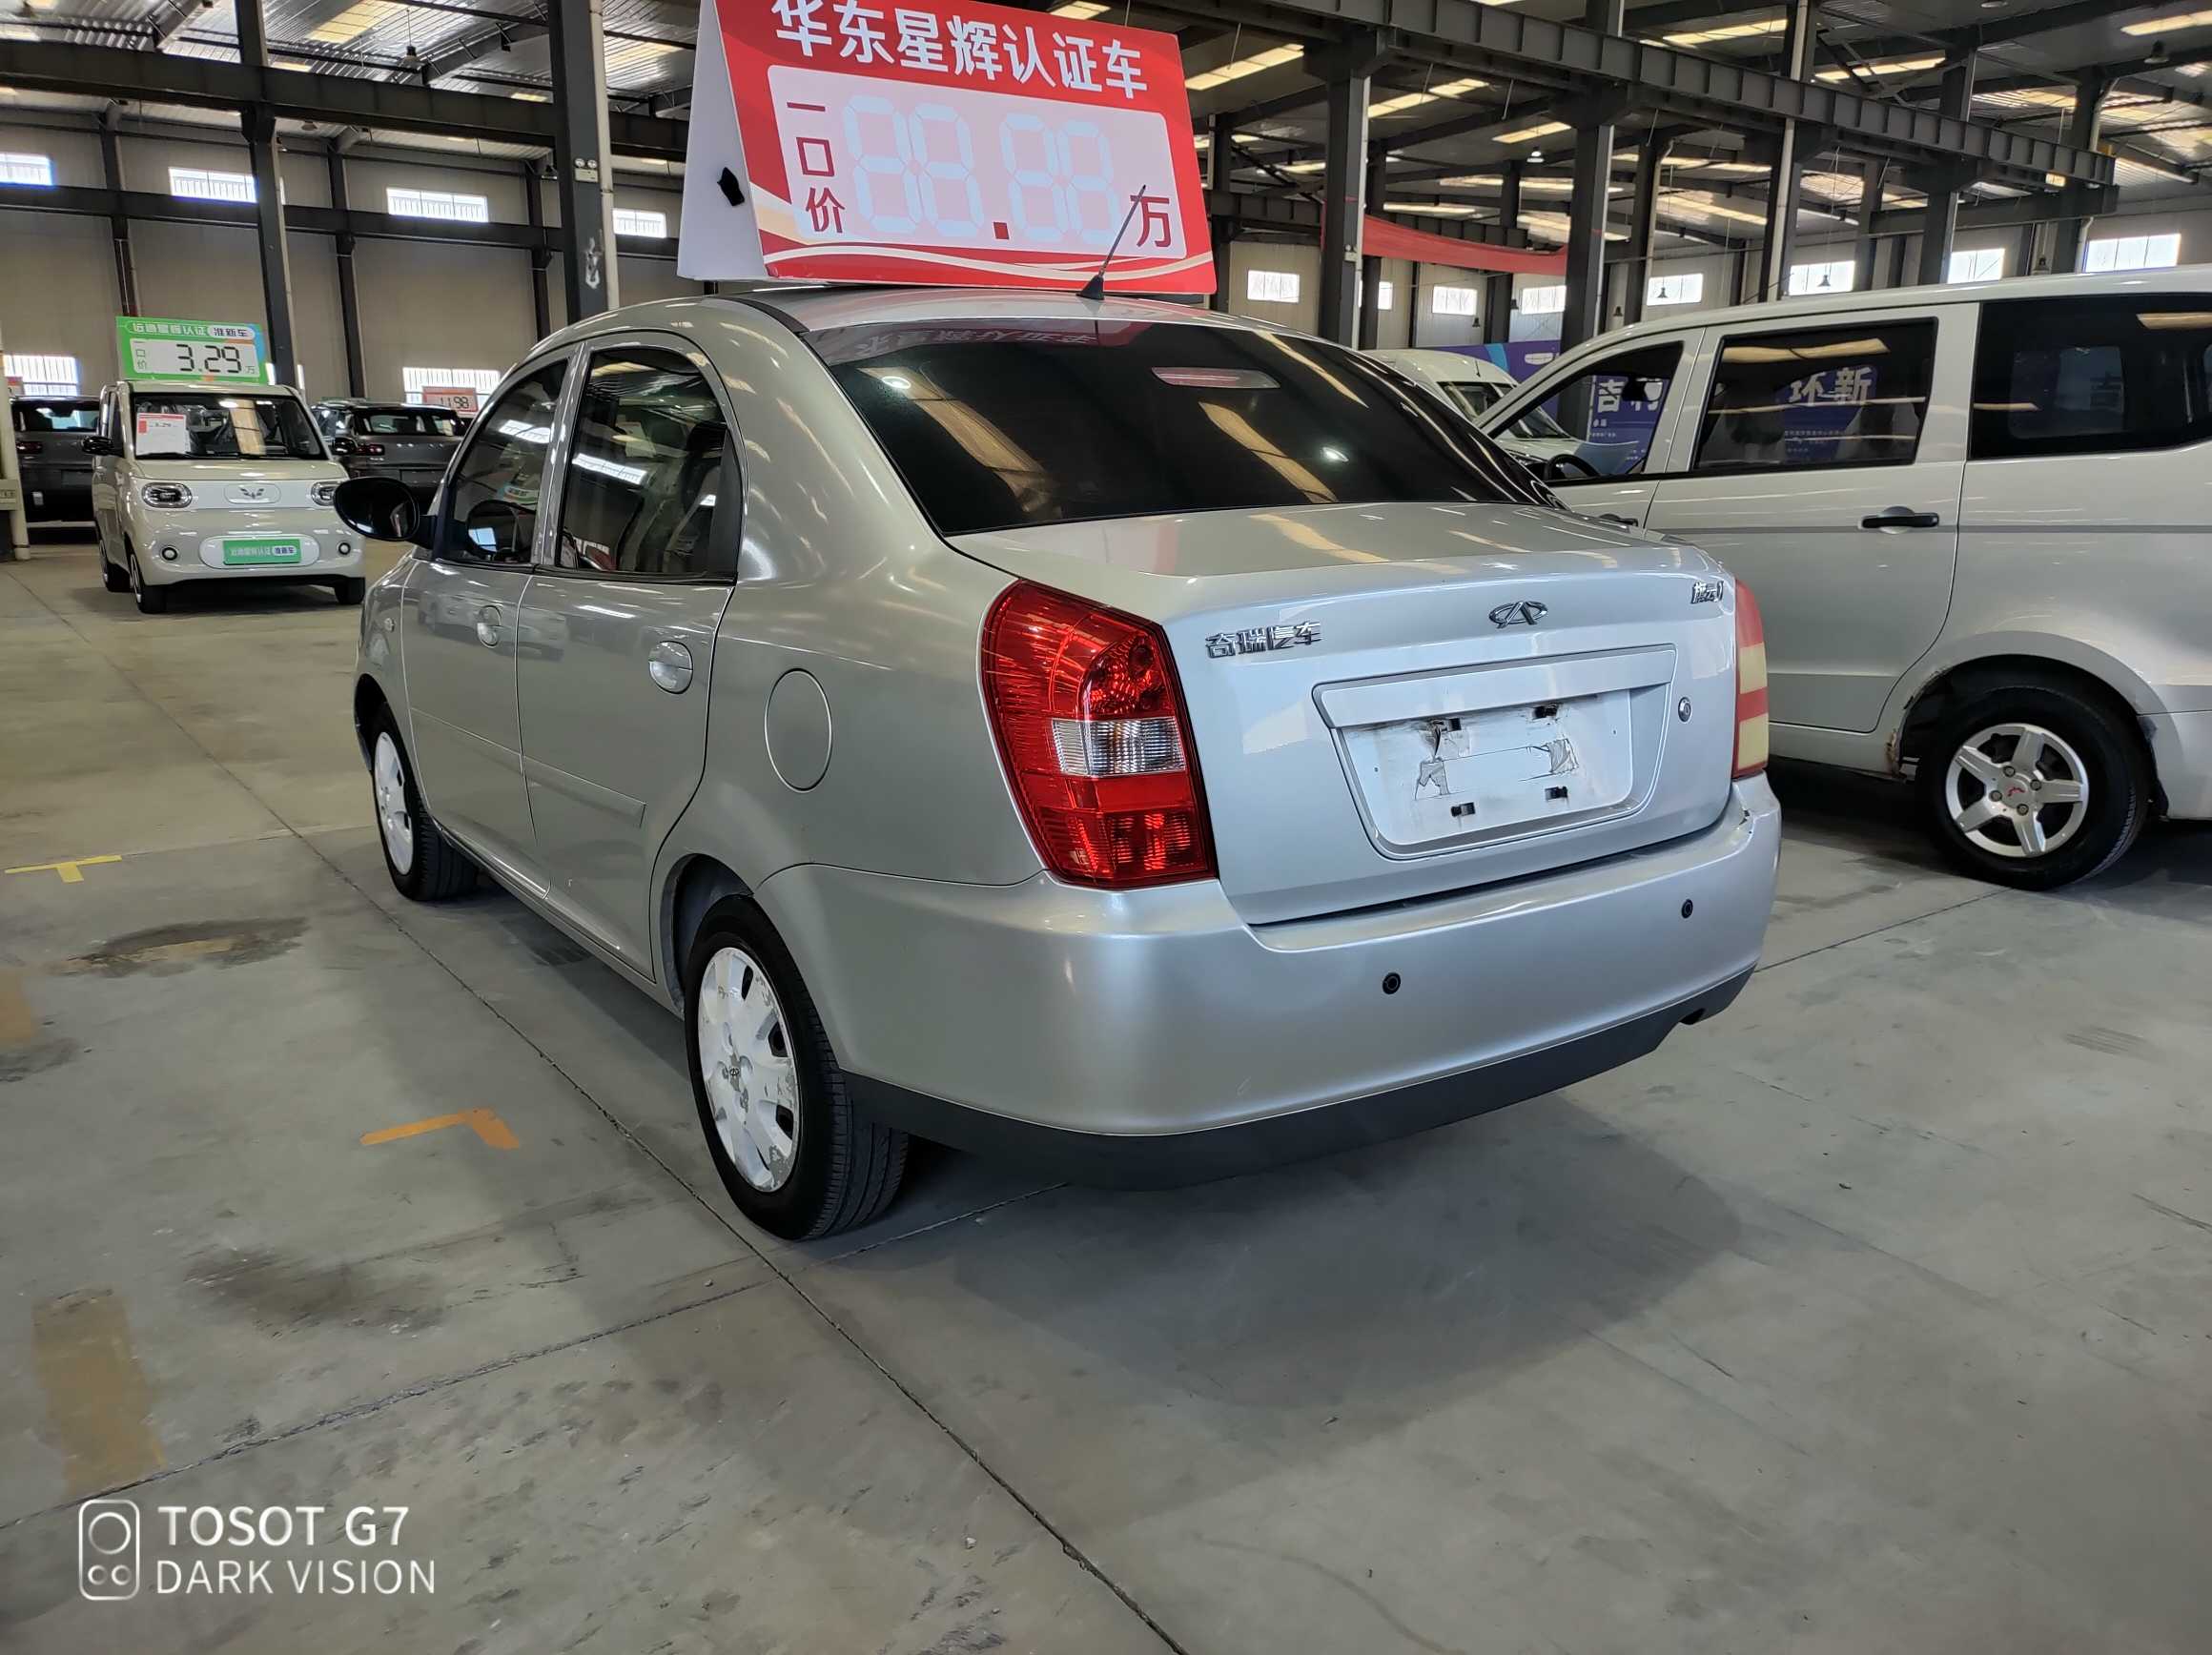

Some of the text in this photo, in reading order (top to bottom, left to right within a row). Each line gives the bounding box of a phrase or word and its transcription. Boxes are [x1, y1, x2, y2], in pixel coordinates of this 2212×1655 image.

[772, 0, 1149, 99] 华东星辉认证车
[787, 100, 846, 235] 一口价
[1130, 194, 1172, 249] 万
[175, 343, 242, 374] 3.29
[1205, 621, 1322, 658] 奇瑞汽车
